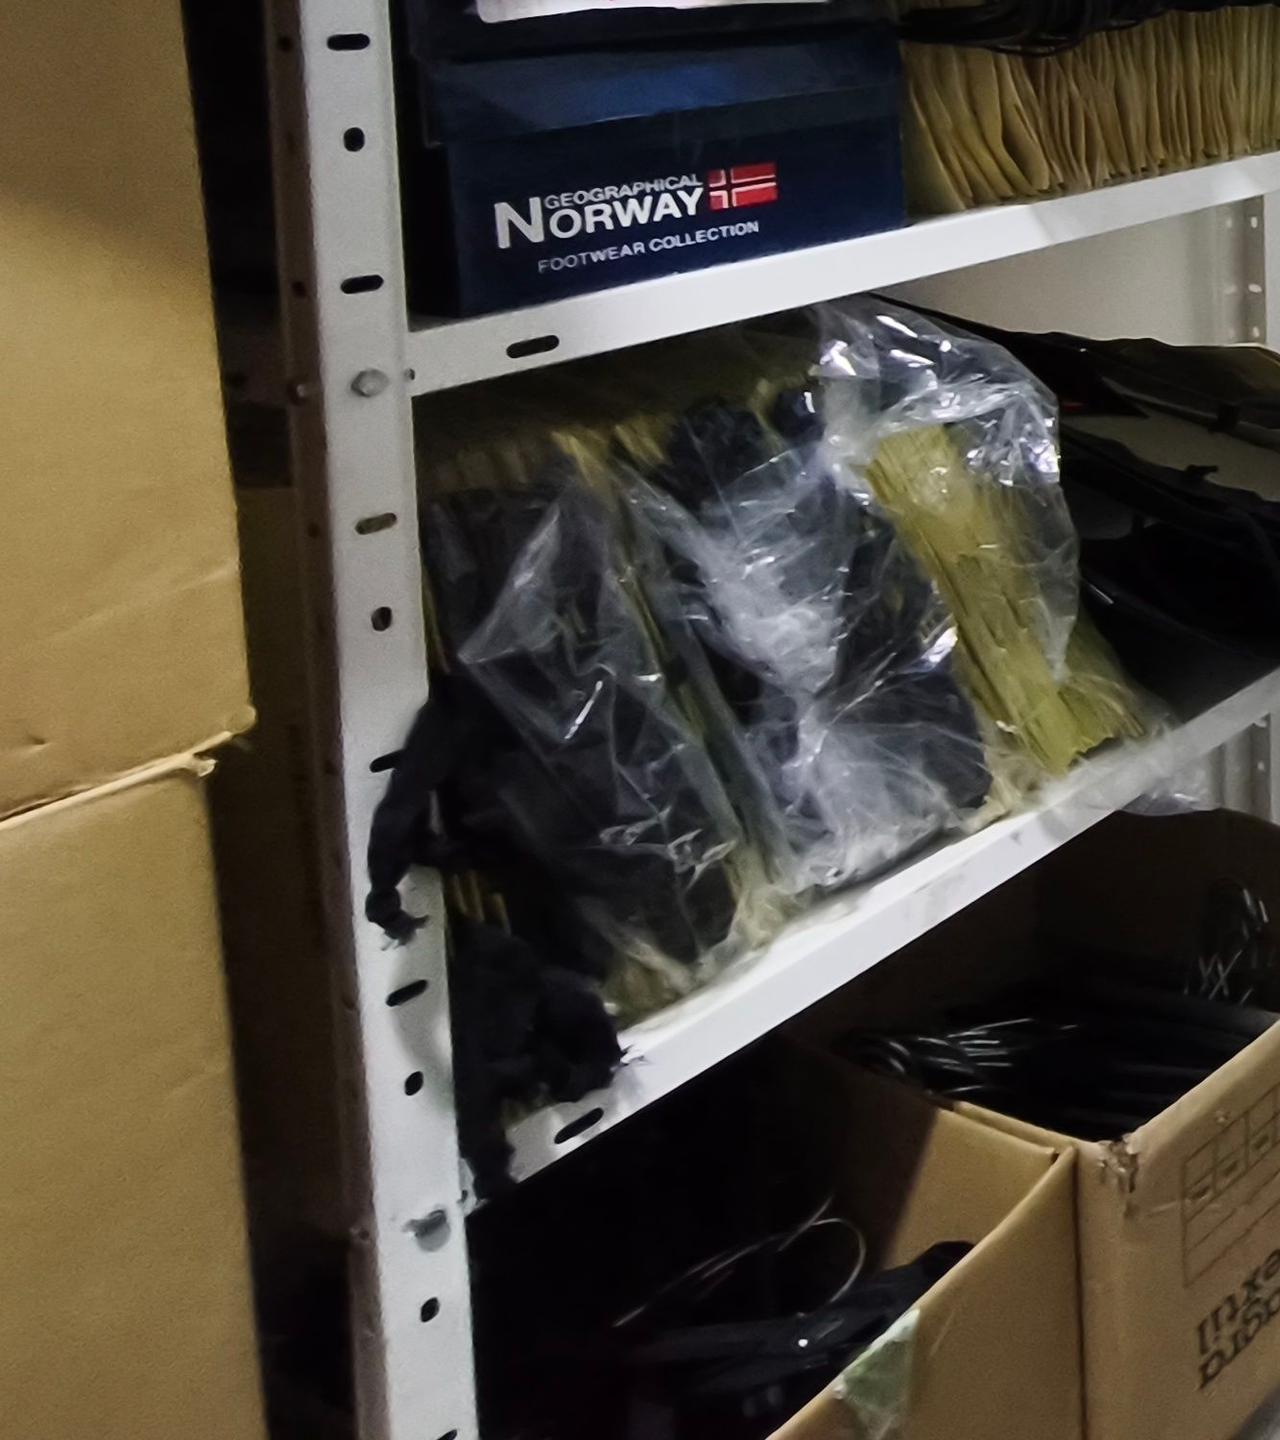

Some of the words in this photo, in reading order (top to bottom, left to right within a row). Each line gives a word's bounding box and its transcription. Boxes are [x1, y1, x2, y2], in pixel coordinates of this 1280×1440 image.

[494, 187, 704, 250] NORWAY
[544, 174, 704, 210] GEOGRAPHICAL
[538, 242, 645, 274] FOOTWEAR
[649, 221, 760, 254] COLLECTION
